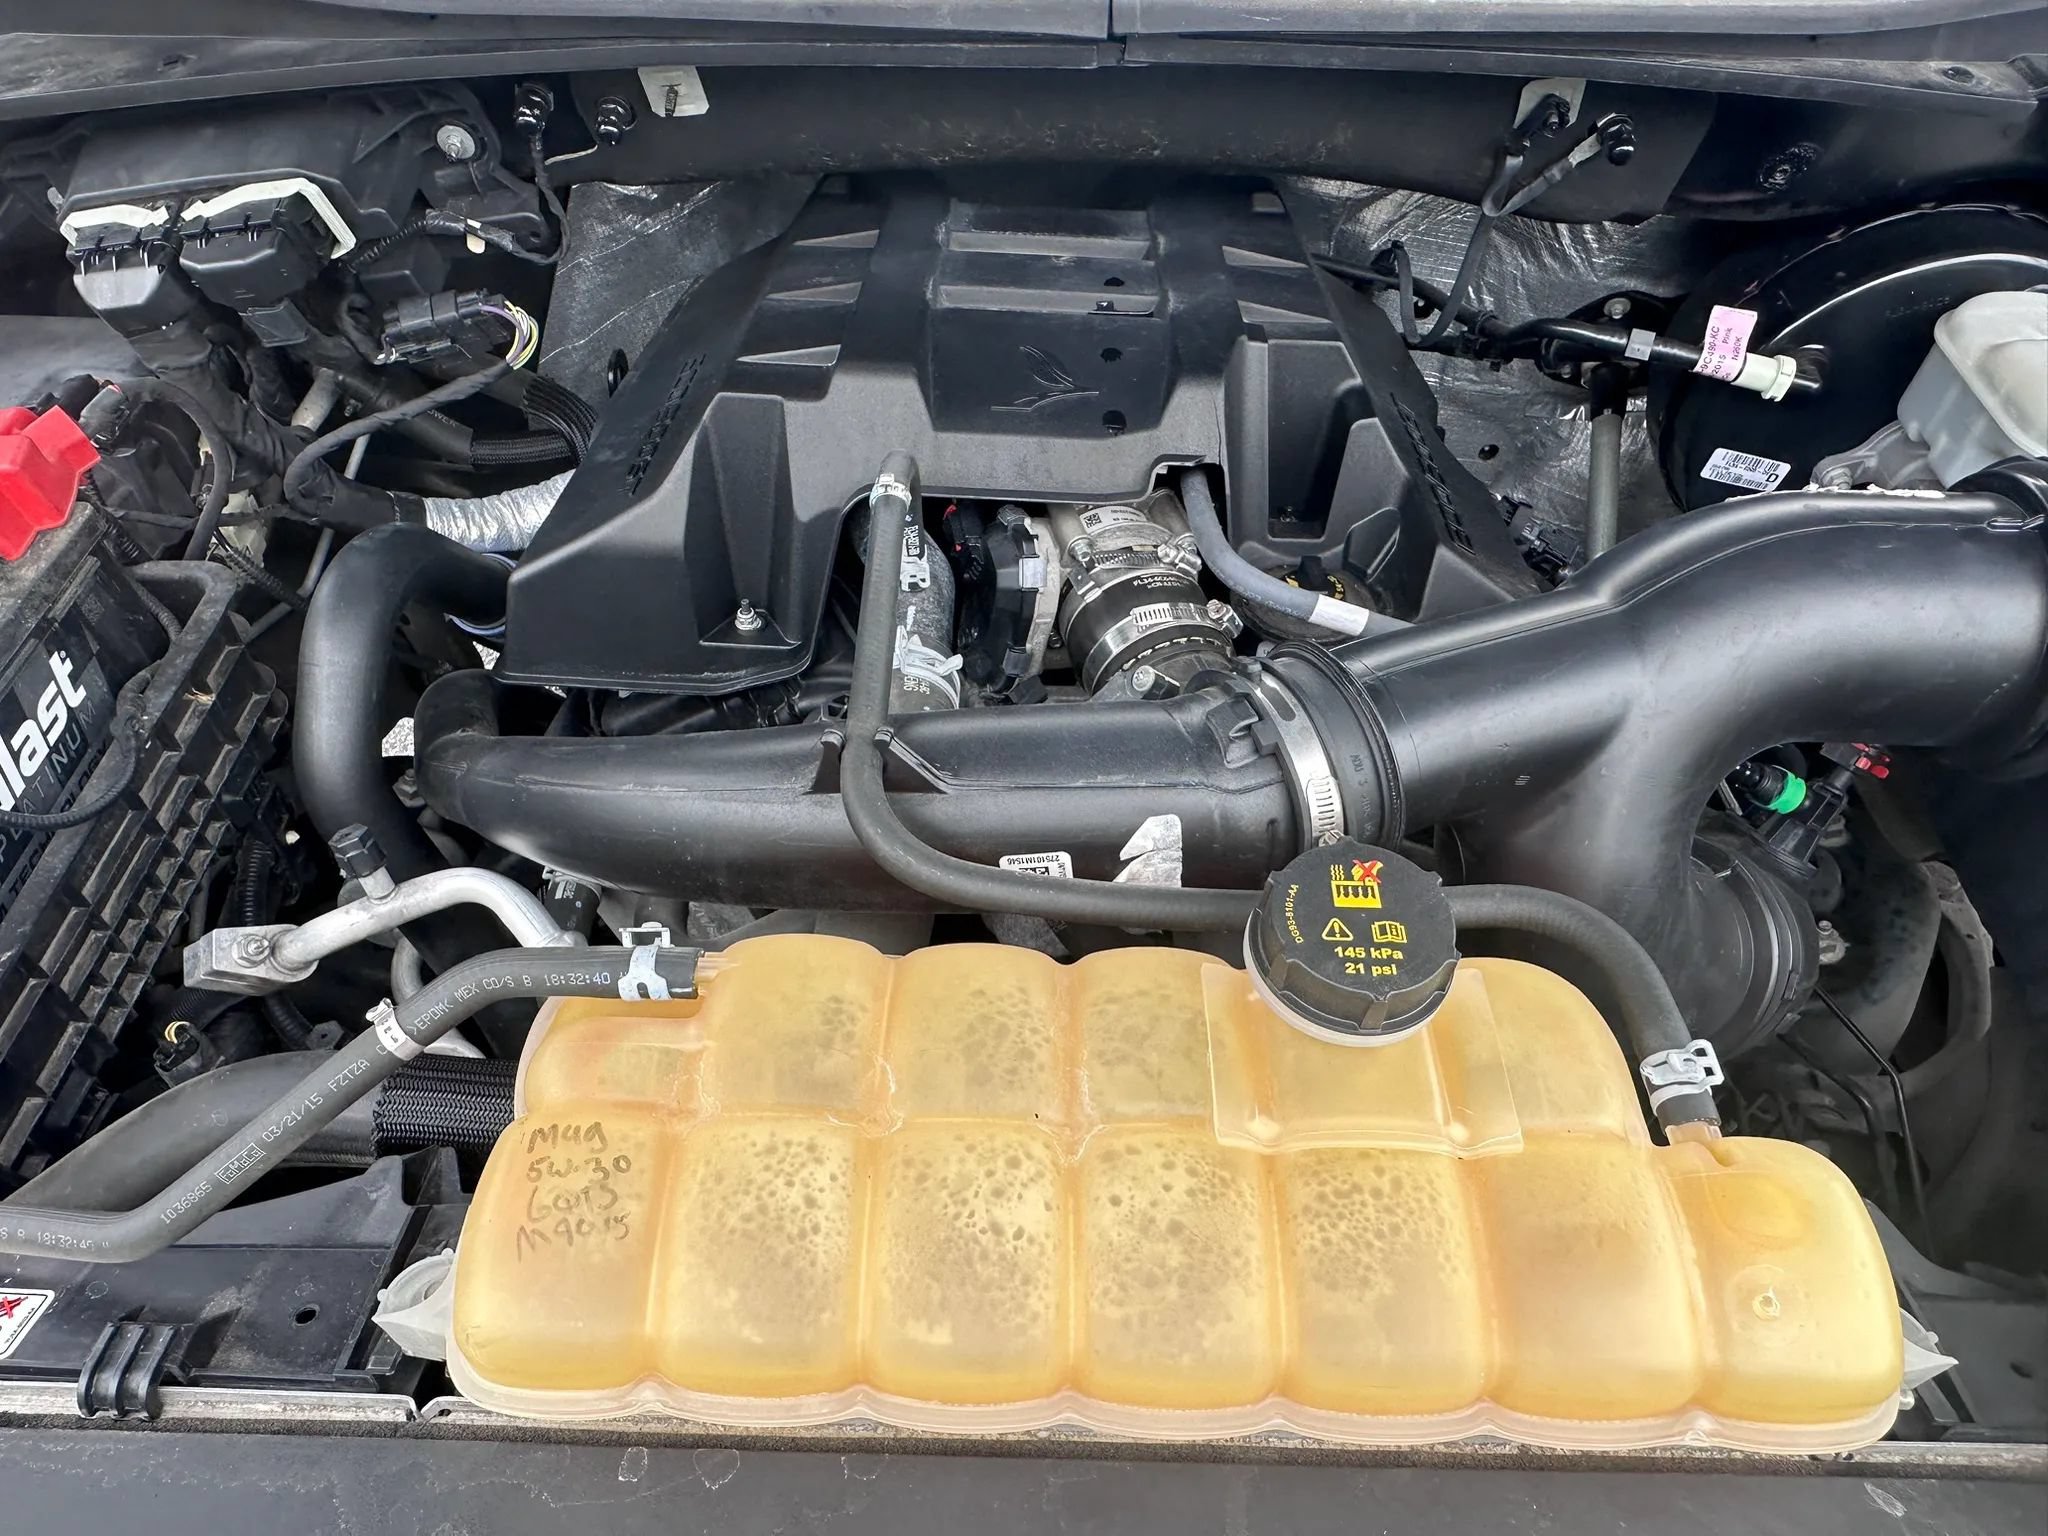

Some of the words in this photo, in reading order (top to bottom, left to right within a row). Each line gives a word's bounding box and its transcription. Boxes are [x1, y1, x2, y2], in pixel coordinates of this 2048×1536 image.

[0, 651, 87, 811] last
[1334, 946, 1366, 959] 145
[1370, 947, 1404, 960] kPa
[1344, 963, 1365, 975] 21
[1371, 964, 1398, 977] psi
[262, 1092, 324, 1143] 03/21/15
[454, 983, 480, 1001] MEX
[544, 971, 611, 986] 18:32:40
